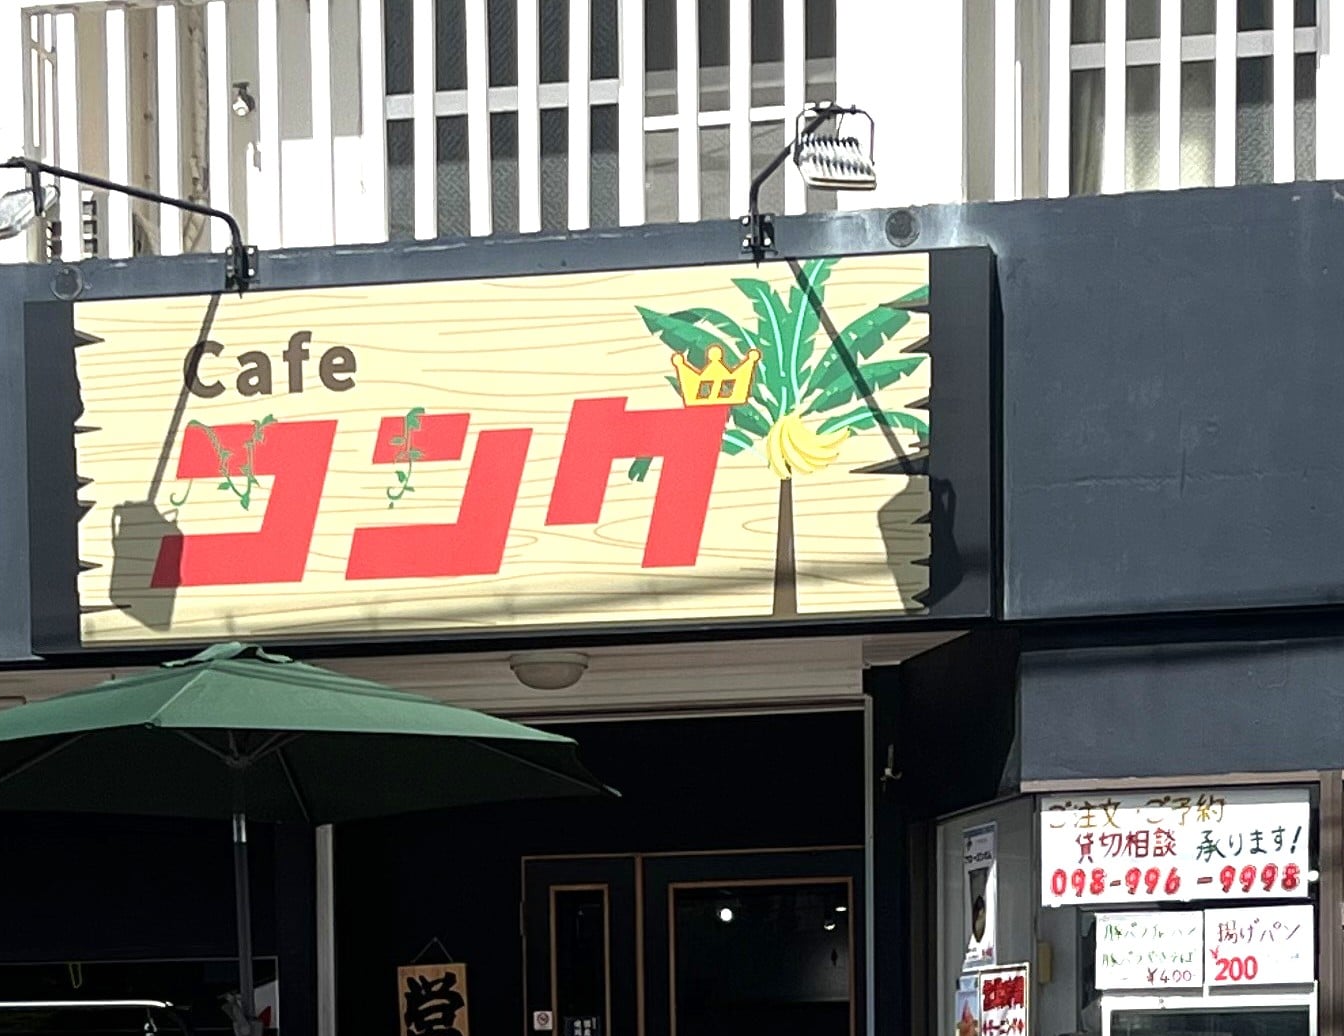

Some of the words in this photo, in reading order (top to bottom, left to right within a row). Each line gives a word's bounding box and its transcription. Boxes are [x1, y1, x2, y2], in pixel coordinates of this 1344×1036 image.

[183, 330, 358, 398] Cafe
[1075, 827, 1178, 864] 貸切相談
[1195, 825, 1302, 862] 承ります!
[1217, 918, 1301, 944] 揚げパン
